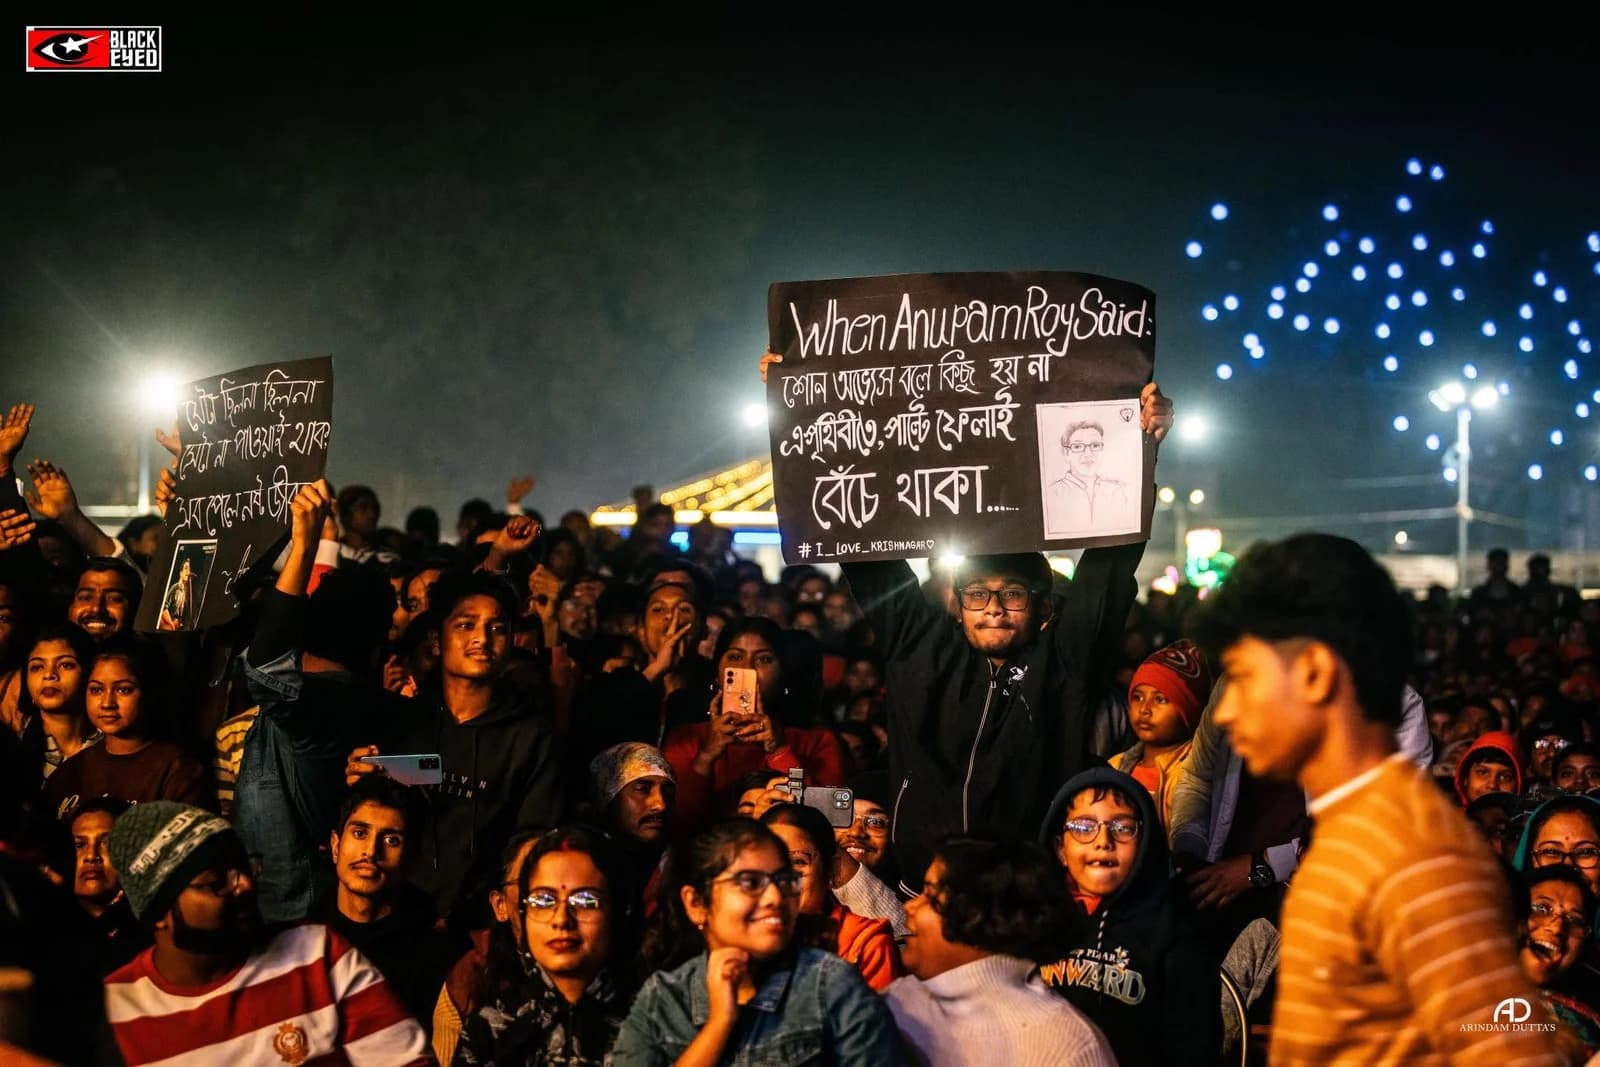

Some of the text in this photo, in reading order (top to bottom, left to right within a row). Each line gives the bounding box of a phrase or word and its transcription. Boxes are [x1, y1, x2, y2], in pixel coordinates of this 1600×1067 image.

[789, 286, 1153, 359] When Anupam Roy Said:
[781, 371, 829, 408] শোন
[898, 364, 934, 399] বলে
[937, 349, 985, 395] কিছু
[988, 355, 1025, 385] হয়
[1027, 353, 1053, 382] না
[935, 385, 1022, 451] ফেলাই
[811, 463, 880, 530] বেঁচে
